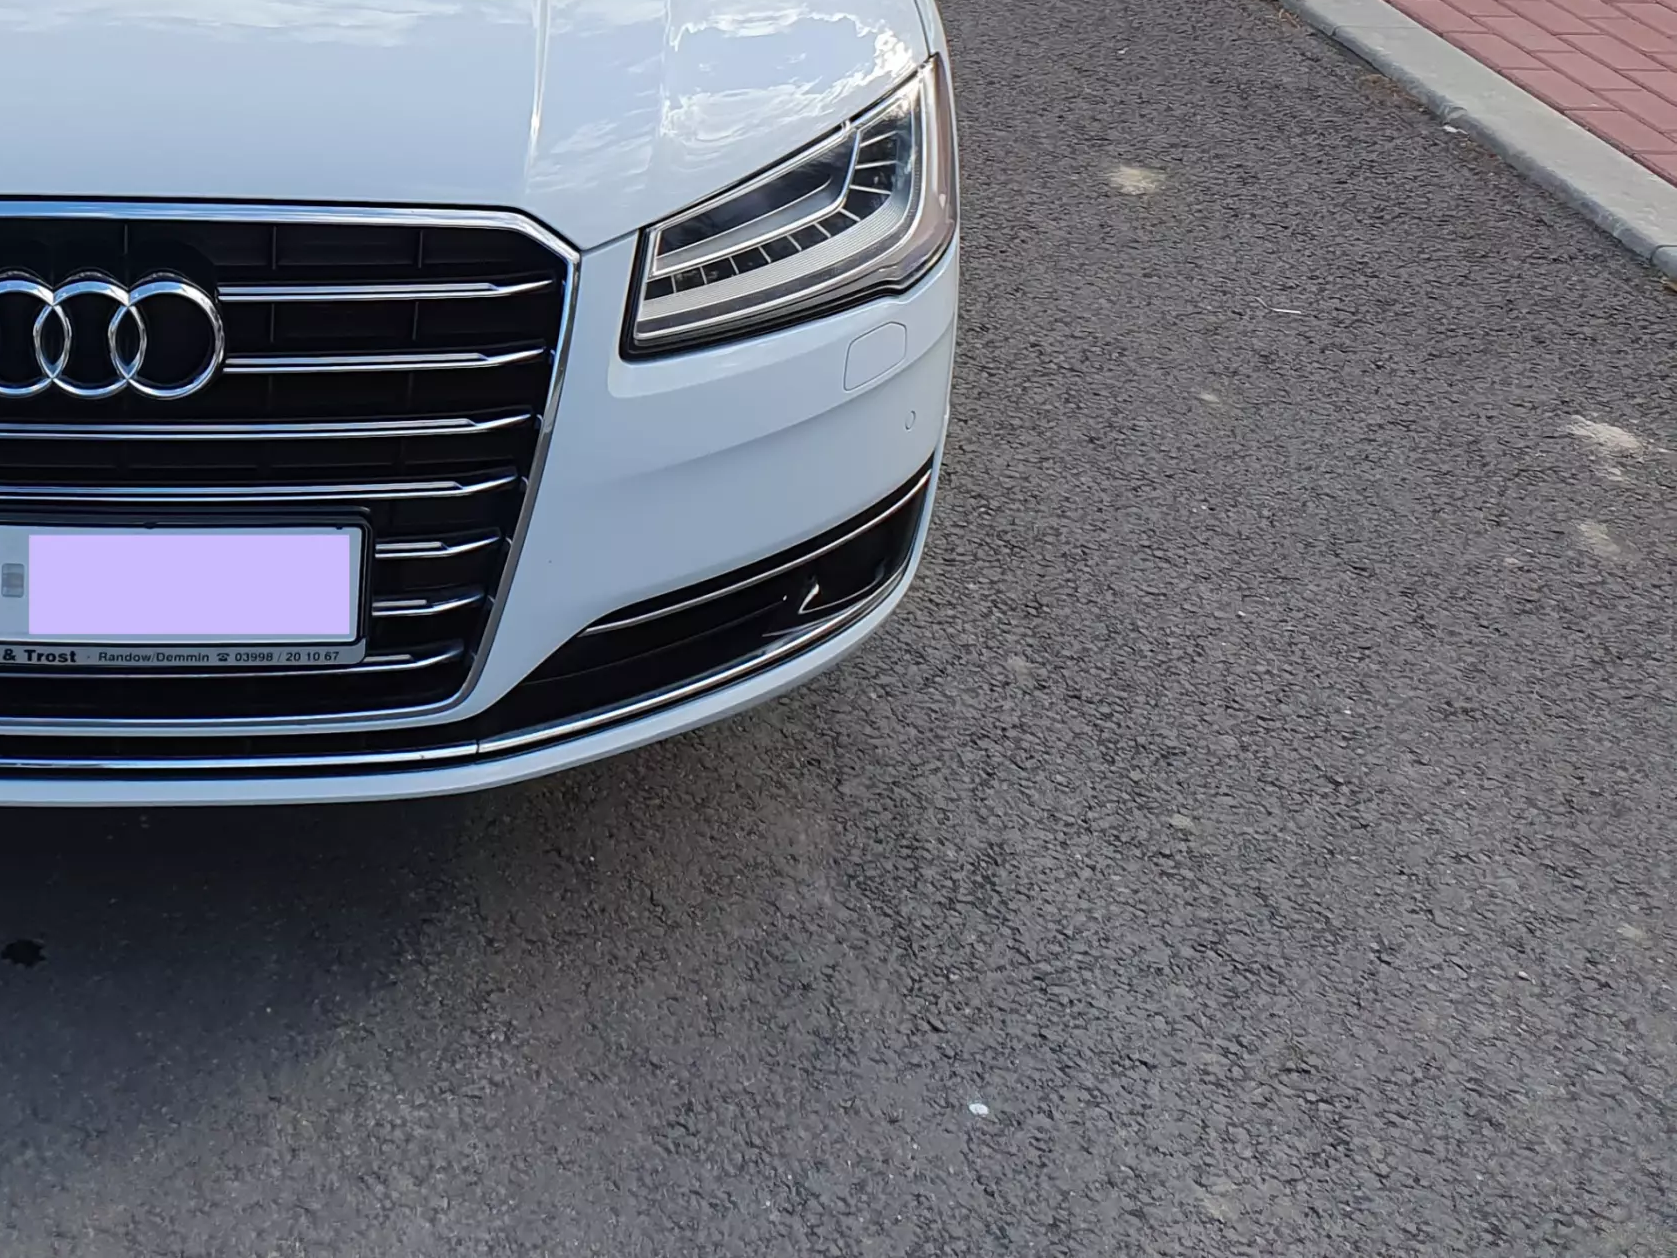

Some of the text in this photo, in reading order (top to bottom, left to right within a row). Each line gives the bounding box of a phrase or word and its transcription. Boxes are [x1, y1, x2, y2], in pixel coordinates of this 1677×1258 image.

[3, 648, 17, 662] &
[24, 649, 77, 663] Trost
[234, 652, 273, 663] 03998
[285, 652, 301, 662] 20
[306, 652, 321, 662] 10
[324, 651, 340, 662] 67
